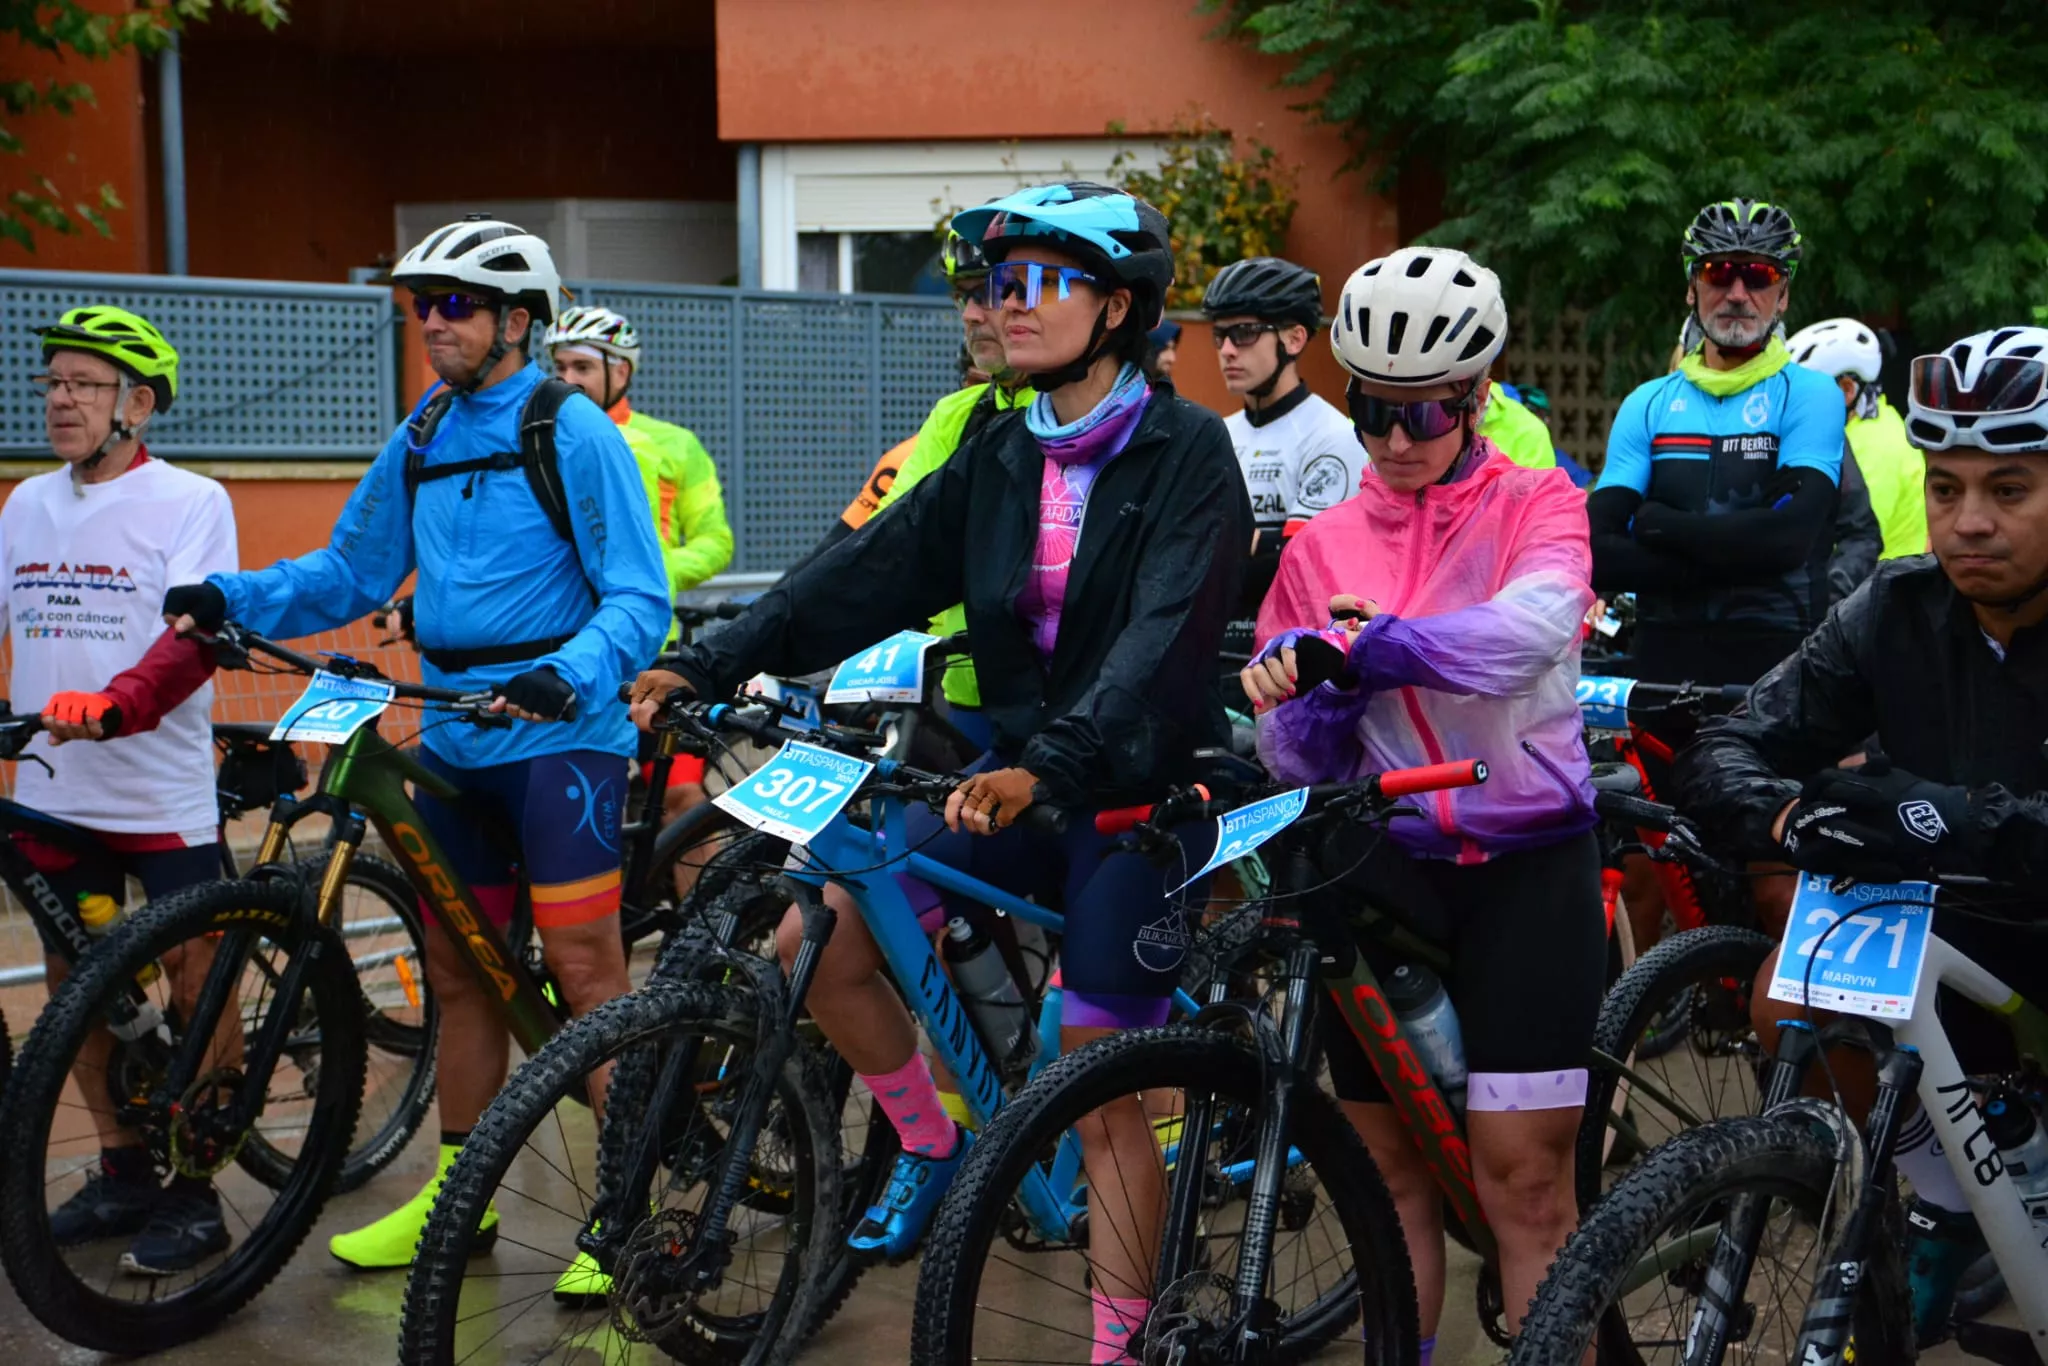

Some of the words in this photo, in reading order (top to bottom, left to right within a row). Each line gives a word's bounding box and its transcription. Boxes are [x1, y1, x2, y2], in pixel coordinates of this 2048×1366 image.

[47, 594, 82, 606] PARA
[47, 611, 73, 622] con
[76, 611, 126, 625] cáncer
[65, 627, 126, 641] ASPANOA
[855, 643, 902, 674] 41
[302, 699, 359, 721] 20
[782, 748, 861, 778] BTTASPANOA
[753, 768, 846, 815] 307
[761, 804, 791, 821] PAULA
[1225, 797, 1301, 834] BTTASPANOA
[1807, 875, 1925, 902] BTASPANOA
[392, 822, 517, 1002] ORBEA
[1899, 904, 1924, 916] 2024
[1796, 907, 1909, 969] 271
[1821, 970, 1878, 988] MARVYN
